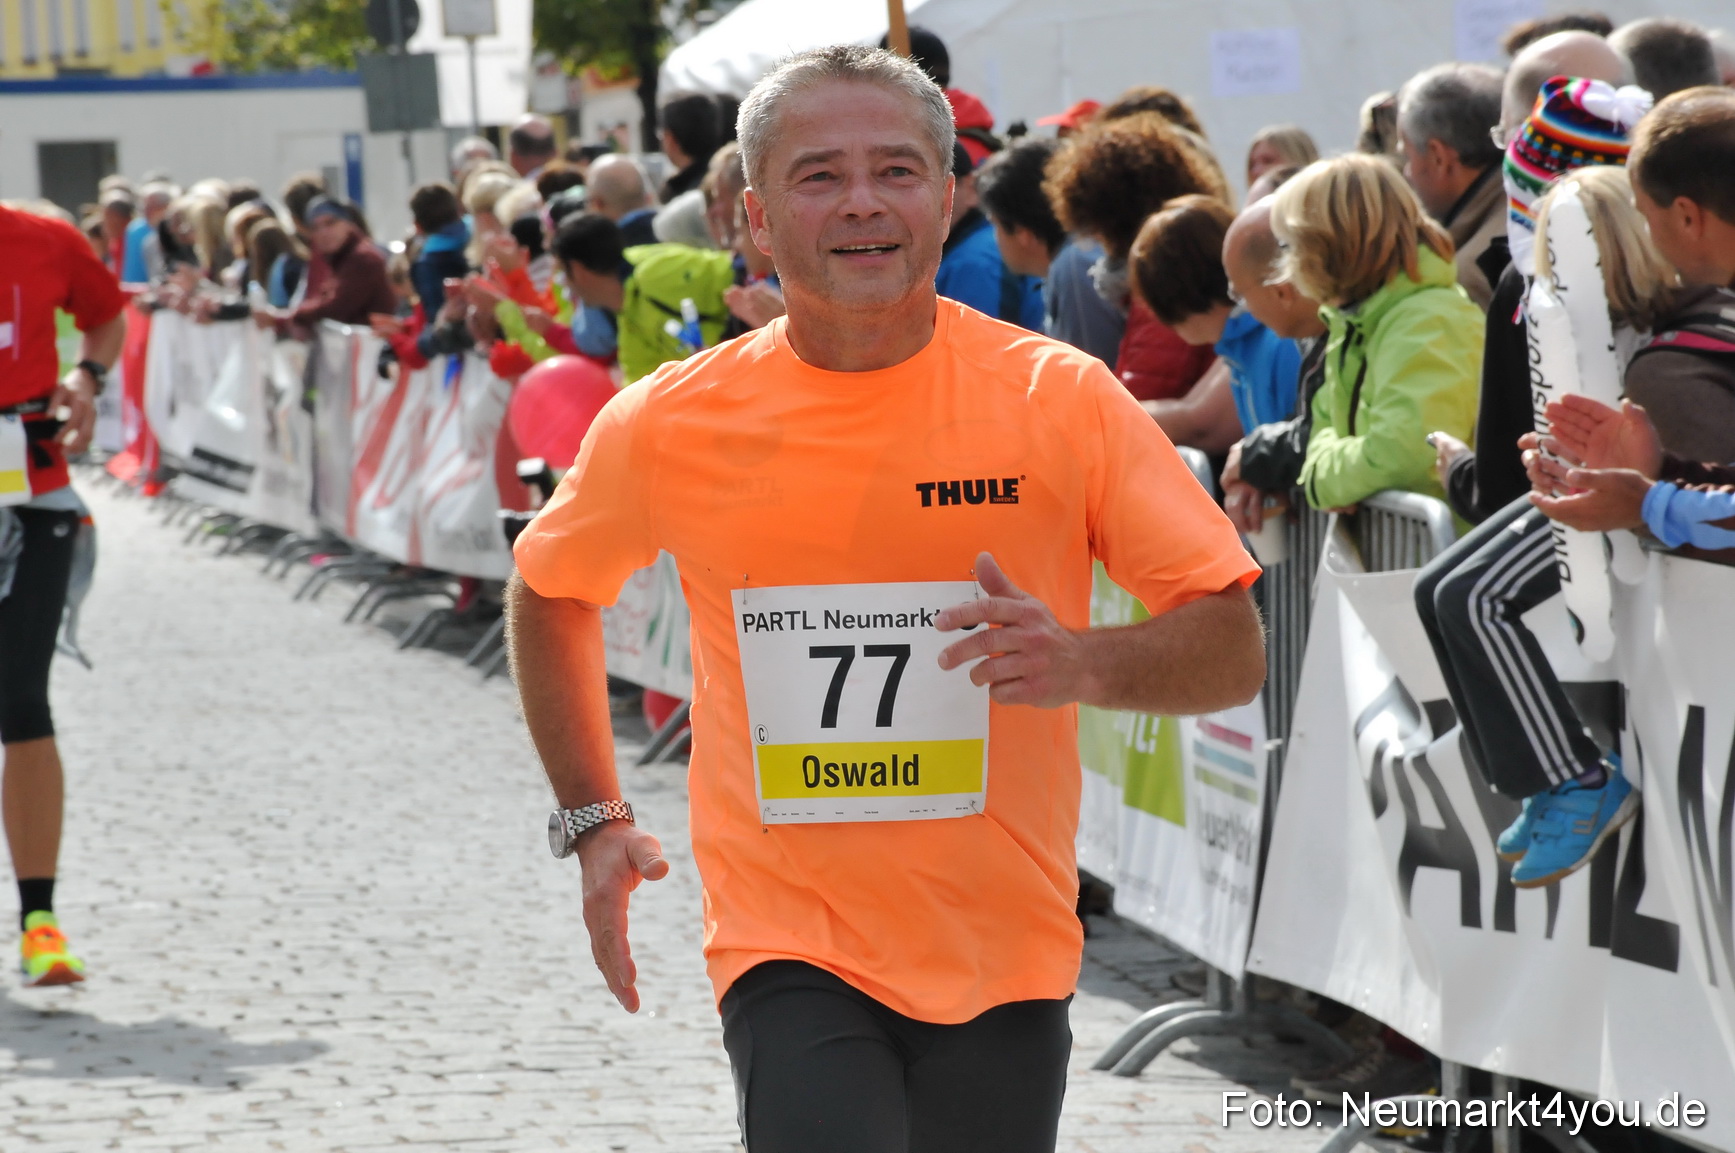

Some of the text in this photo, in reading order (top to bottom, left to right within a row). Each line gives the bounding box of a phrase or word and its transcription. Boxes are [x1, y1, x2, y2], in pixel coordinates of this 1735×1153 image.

[915, 477, 1020, 508] THULE
[742, 611, 817, 633] PARTL
[808, 643, 912, 729] 77
[801, 753, 921, 789] Oswald
